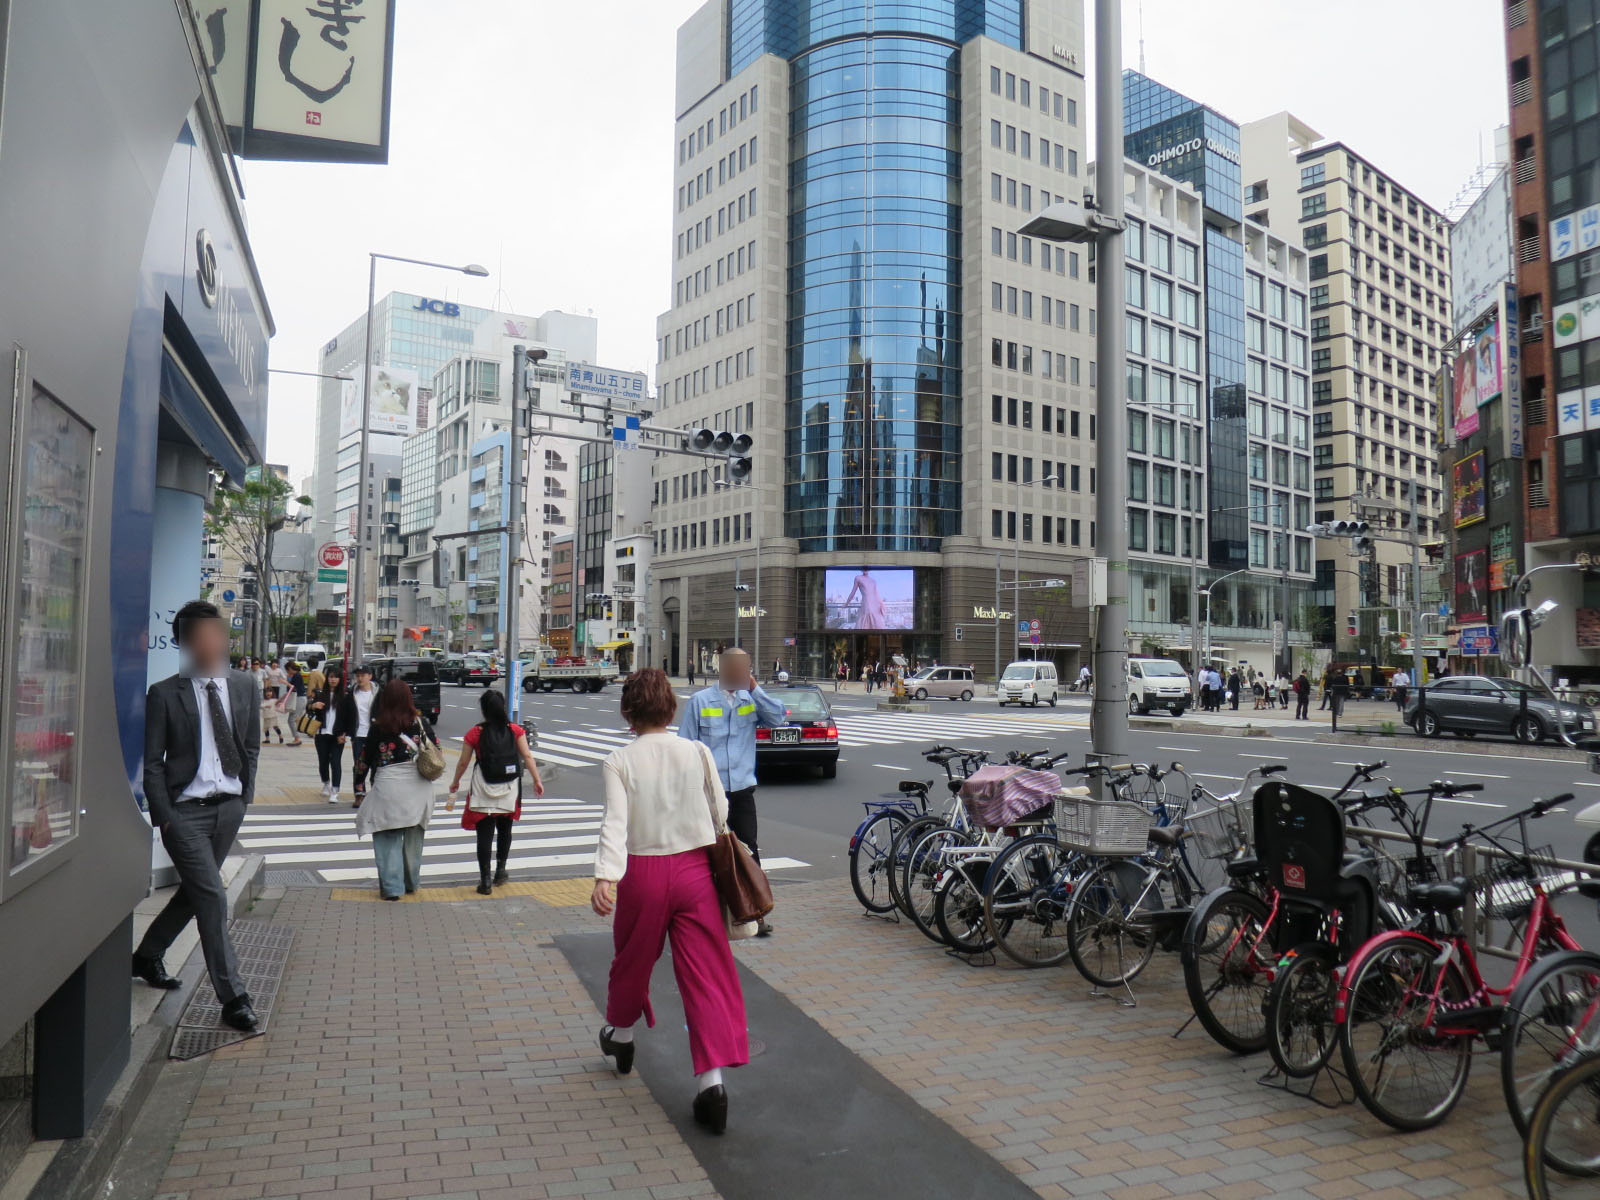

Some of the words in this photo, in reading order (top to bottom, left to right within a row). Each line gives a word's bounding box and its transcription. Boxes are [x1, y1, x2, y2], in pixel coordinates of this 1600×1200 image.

[1148, 138, 1201, 166] OHMOTO
[1207, 138, 1240, 165] OHMOTO
[412, 297, 460, 317] JCB
[217, 269, 255, 396] MEVIUS
[570, 369, 643, 392] 南青山五丁目
